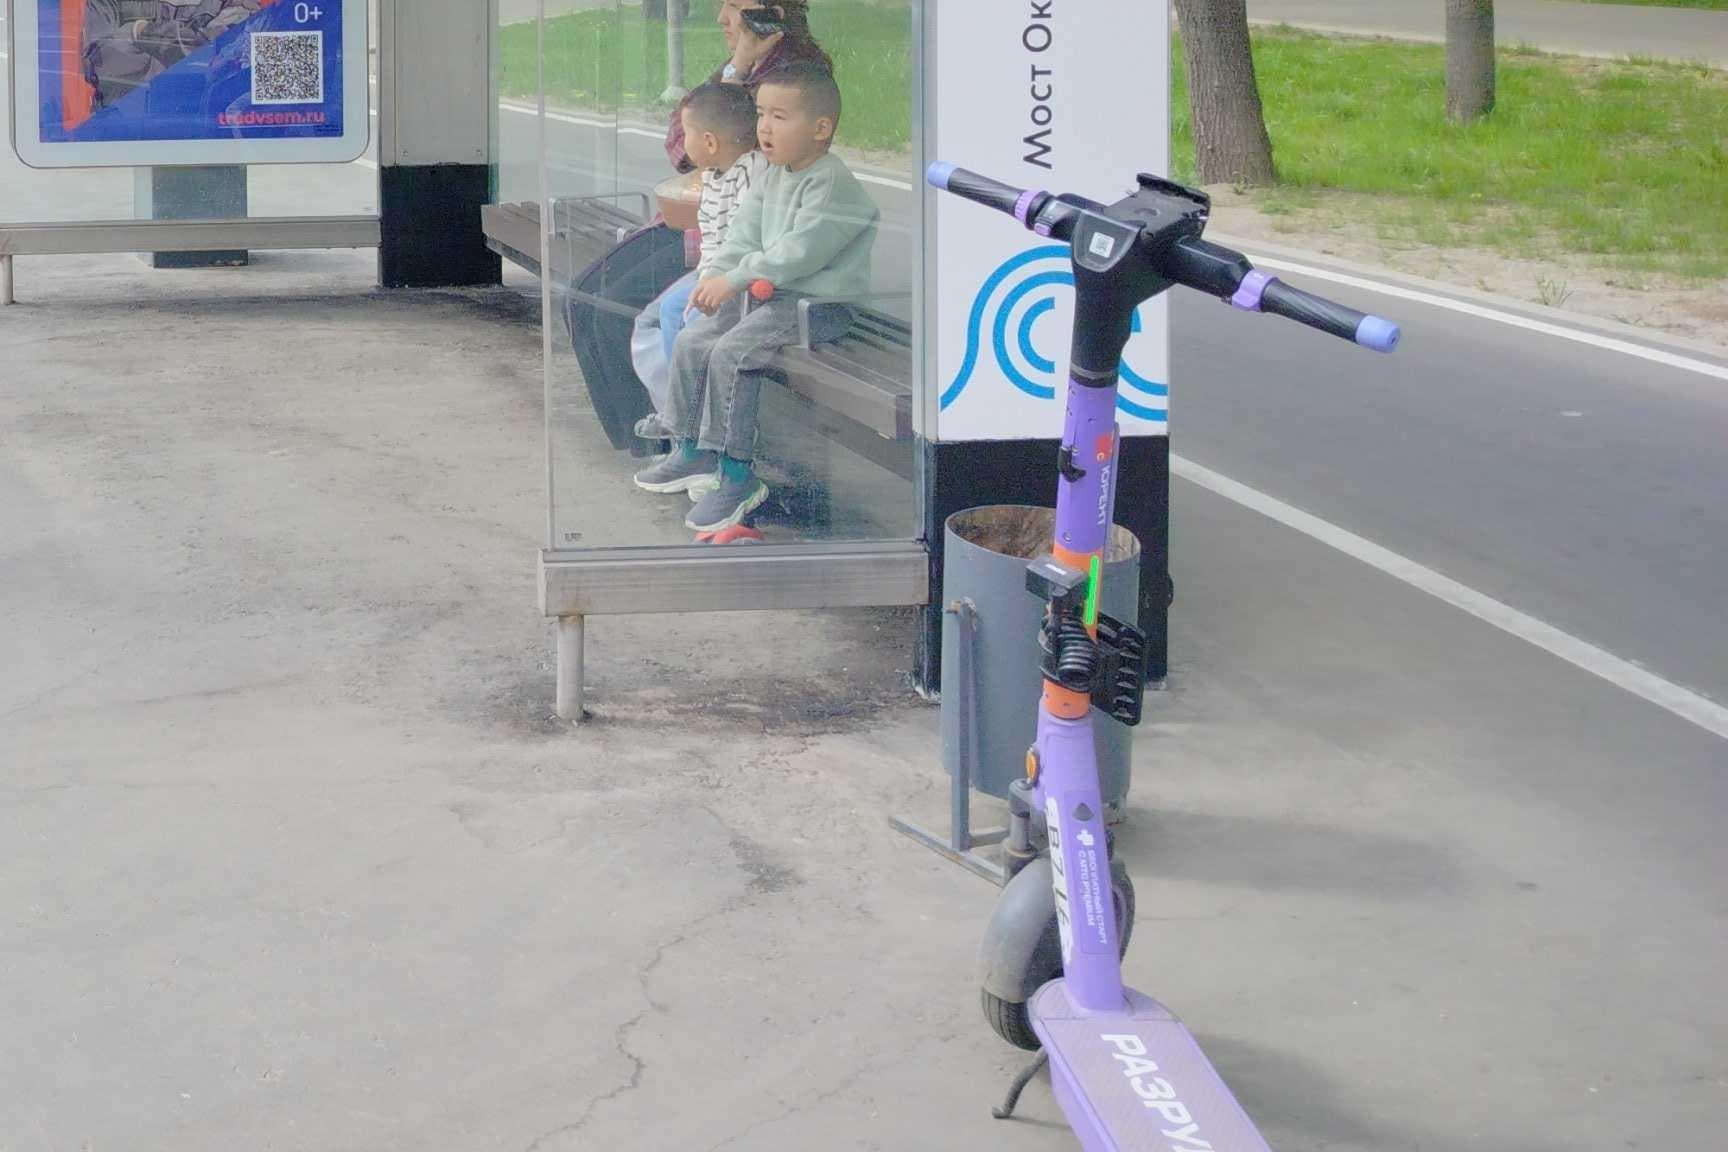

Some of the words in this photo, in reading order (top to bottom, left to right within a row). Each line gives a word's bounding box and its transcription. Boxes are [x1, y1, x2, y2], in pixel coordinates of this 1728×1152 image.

[294, 1, 323, 24] 0+
[1022, 63, 1053, 170] Мост
[1099, 1033, 1216, 1152] РАЗРУ
